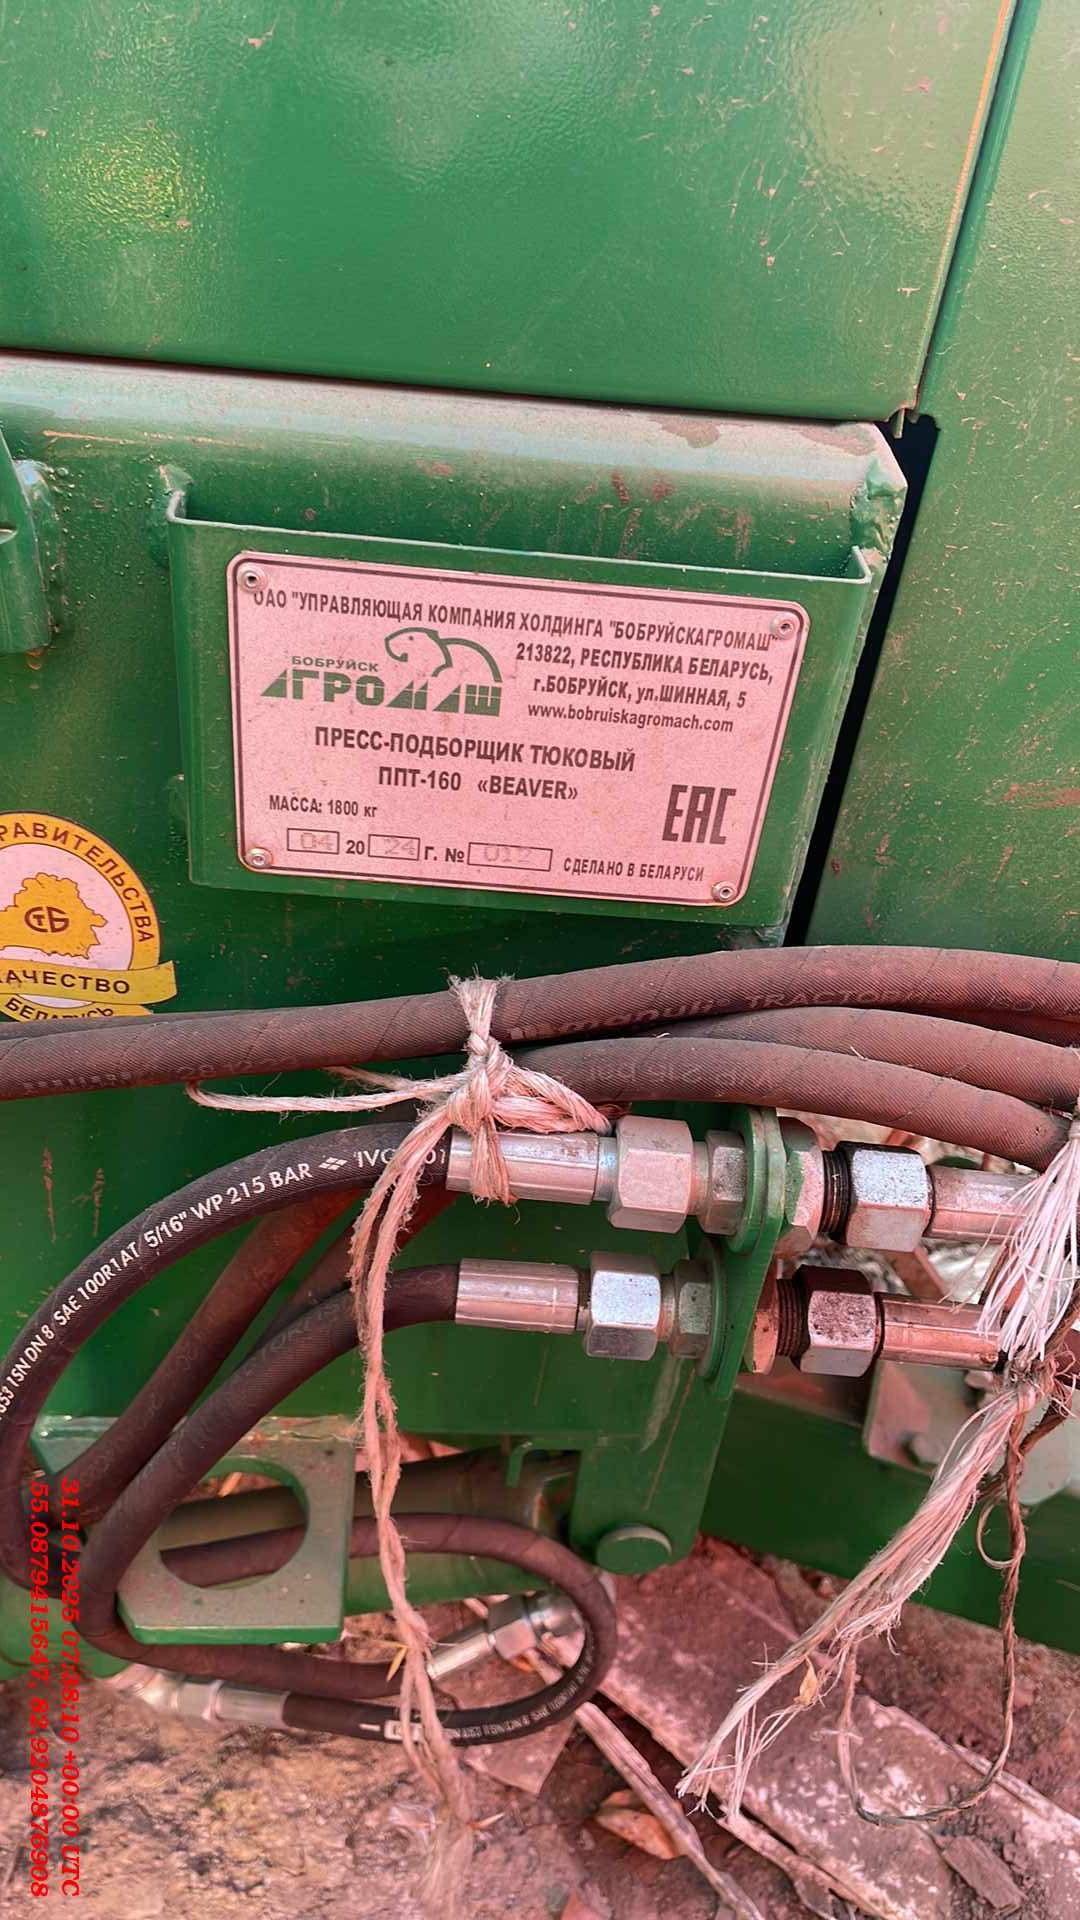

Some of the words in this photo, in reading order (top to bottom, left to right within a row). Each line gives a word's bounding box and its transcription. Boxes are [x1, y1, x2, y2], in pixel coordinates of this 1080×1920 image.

[253, 590, 287, 609] ОАО
[292, 592, 422, 621] "УПРАВЛЯЮЩАЯ
[428, 604, 515, 630] КОМПАНИЯ
[519, 612, 603, 638] ХОЛДИНГА
[609, 620, 778, 651] "БОБРУЙСКАГРОМАШ"
[291, 655, 380, 672] БОБРУЙСК
[516, 642, 575, 668] 213822,
[580, 648, 683, 675] РЕСПУБЛИКА
[688, 657, 773, 685] БЕЛАРУСЬ,
[260, 668, 501, 717] АГРОМАШ
[533, 675, 632, 703] г.БОБРУЙСК,
[637, 684, 731, 711] ул.ШИННАЯ,
[736, 690, 747, 708] 5
[527, 703, 734, 732] www.bobruiskagromach.com
[315, 726, 524, 764] ПРЕСС-ПОДБОРЩИК
[531, 745, 636, 772] ТЮКОВЫЙ
[378, 766, 462, 791] ППТ-160
[477, 774, 578, 800] «BEAVER»
[269, 794, 322, 813] МАССА:
[328, 800, 359, 816] 1800
[364, 806, 377, 818] кг
[345, 840, 365, 855] 20
[445, 848, 464, 863] №
[0, 822, 155, 942] РАВИТЕЛЬСТВА
[563, 857, 623, 876] СДЕЛАНО
[627, 863, 635, 876] В
[639, 863, 704, 881] БЕЛАРУСИ
[0, 969, 130, 994] АЧЕСТВО
[5, 997, 114, 1020] БЕЛСЬ
[24, 1335, 47, 1362] DN
[41, 1324, 55, 1340] 8
[54, 1299, 84, 1327] SAE
[77, 1242, 140, 1296] 100R1AT
[144, 1213, 188, 1249] 5/16"
[190, 1194, 223, 1223] WP
[228, 1175, 267, 1206] 215
[269, 1162, 314, 1190] BAR
